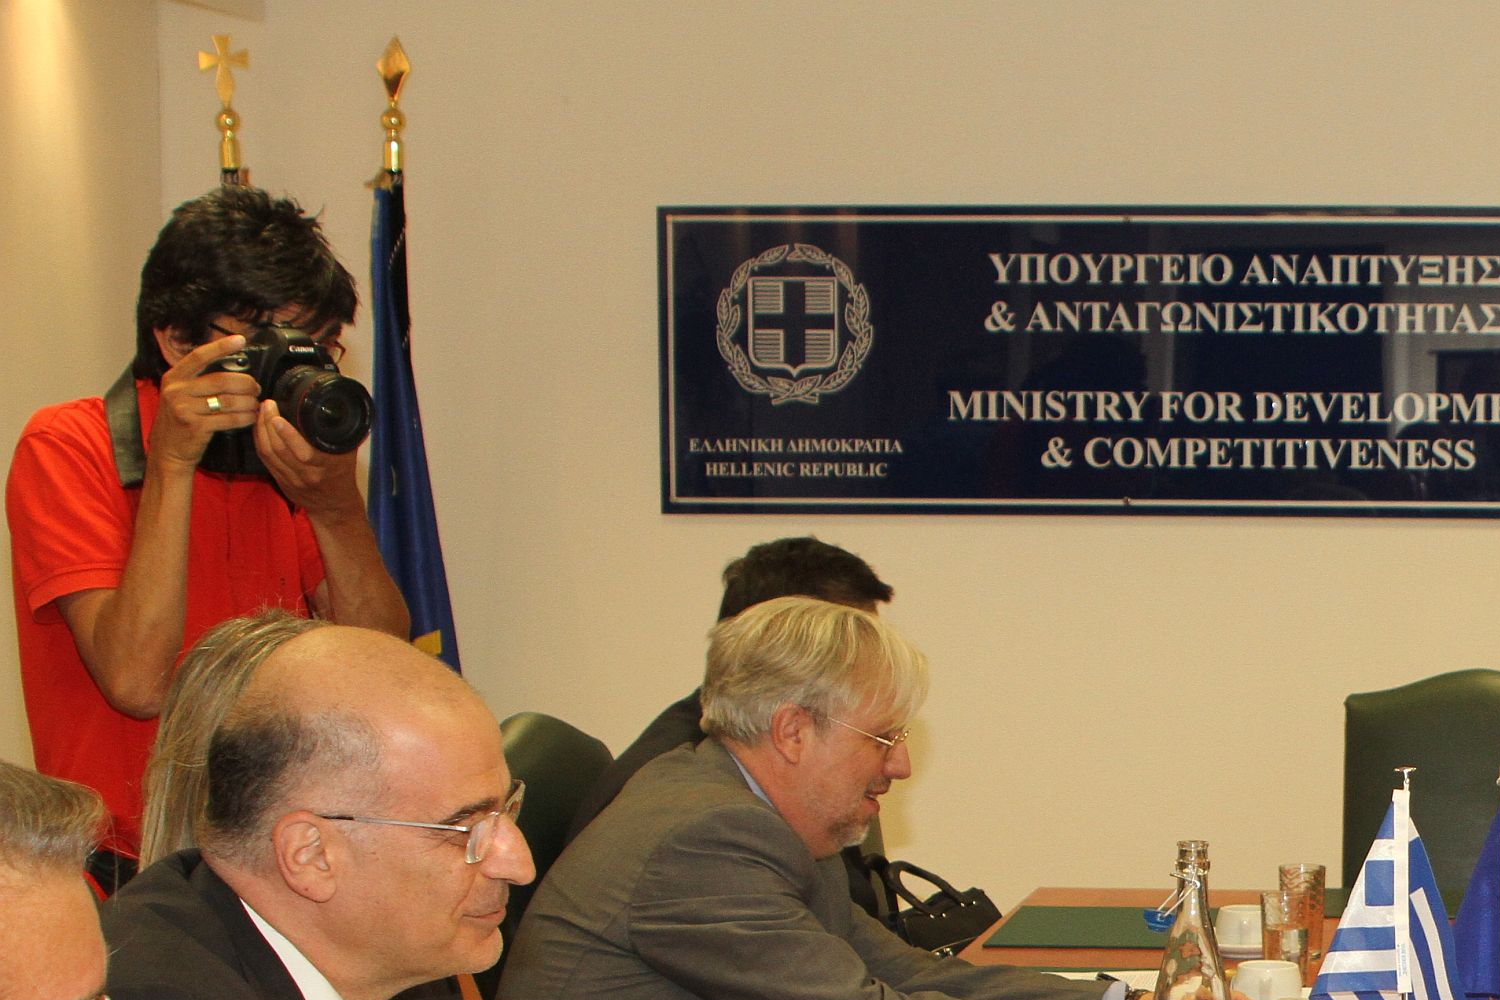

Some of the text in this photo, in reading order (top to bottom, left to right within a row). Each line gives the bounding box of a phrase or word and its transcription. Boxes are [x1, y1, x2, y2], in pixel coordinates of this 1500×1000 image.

[988, 253, 1235, 285] ΥΠΟΥΡΓΕΙΟ
[983, 302, 1015, 333] &
[947, 390, 1152, 422] MINISTRY
[1158, 391, 1244, 422] FOR
[689, 438, 903, 453] ΕΛΛΗΝΙΚΗ ΔΗΜΟΚΡΑΤΙΑ
[1040, 437, 1477, 470] & COMPETITIVENESS
[705, 462, 887, 477] HELLENIC REPUBLIC
